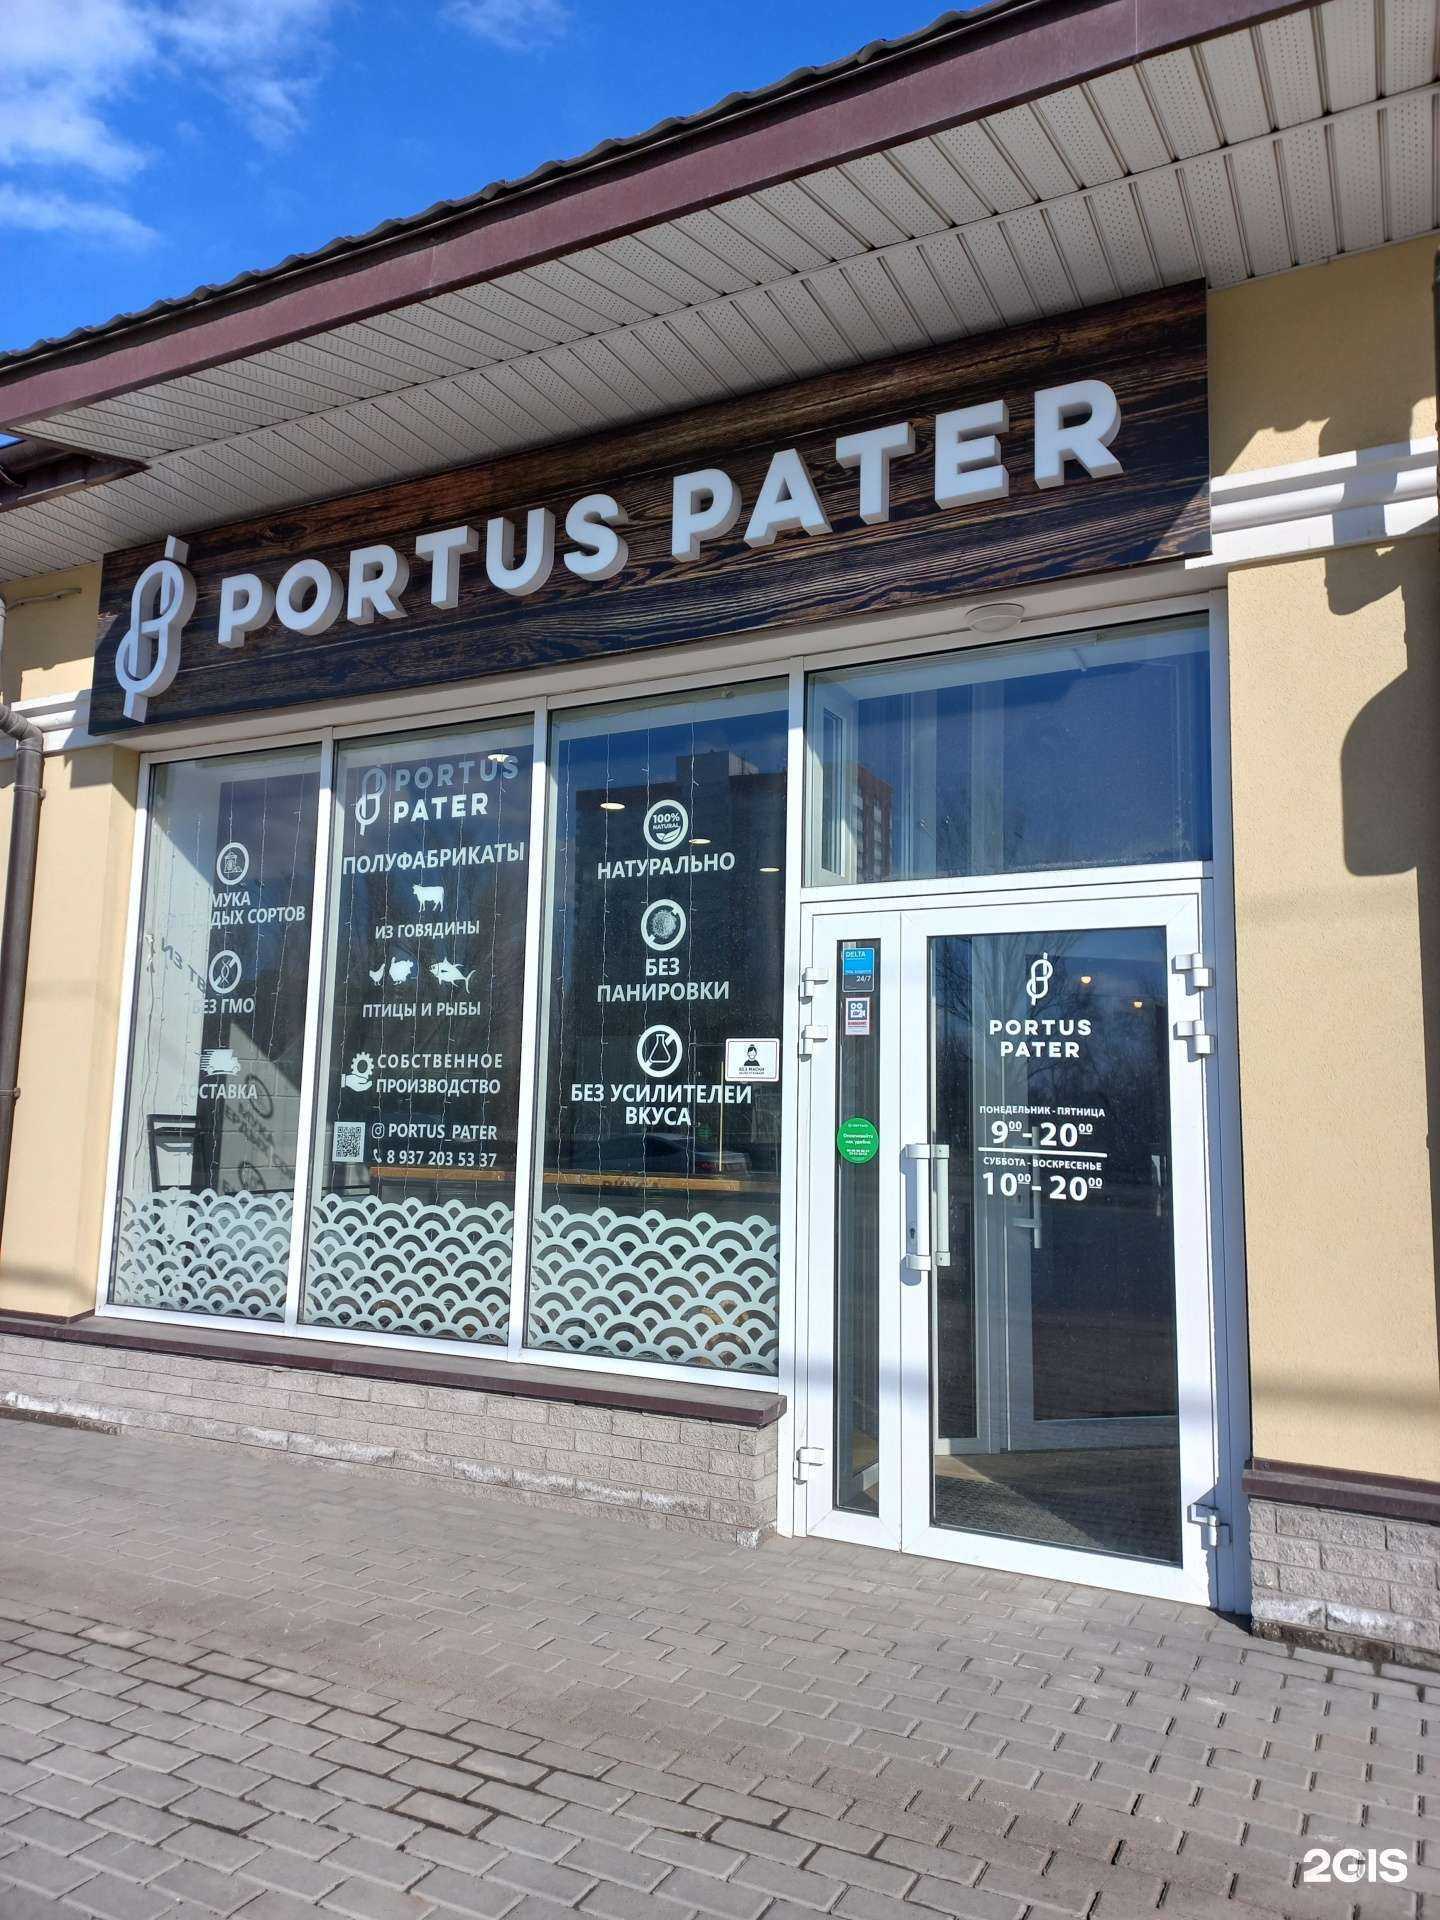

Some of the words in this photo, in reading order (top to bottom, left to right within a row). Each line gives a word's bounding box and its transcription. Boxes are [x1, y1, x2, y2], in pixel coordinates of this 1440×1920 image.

[219, 494, 629, 648] PORTUS
[671, 379, 1122, 562] PATER
[395, 755, 519, 791] PORTUS
[394, 793, 488, 823] PATER
[652, 812, 680, 824] 100%
[343, 842, 524, 874] ПОЛУФАБРИКАТЫ
[597, 852, 736, 880] НАТУРАЛЬНО
[212, 891, 250, 907] МУКА
[248, 906, 305, 924] СОРТОВ
[375, 924, 394, 940] ИЗ
[398, 920, 480, 939] ГОВЯДИНЫ
[645, 957, 680, 977] БЕЗ
[597, 981, 730, 1003] ПАНИРОВКИ
[221, 998, 254, 1014] ГМО
[363, 1003, 416, 1019] ПТИЦЫ
[421, 1003, 431, 1017] И
[436, 1001, 481, 1017] РЫБЫ
[989, 1019, 1092, 1036] PORTUS
[1000, 1041, 1080, 1058] PATER
[377, 1053, 503, 1069] СОБСТВЕННОЕ
[183, 1083, 258, 1100] СТАВКА
[376, 1078, 500, 1097] ПРОИЗВОДСТВО
[571, 1083, 603, 1102] БЕЗ
[625, 1106, 692, 1126] ВКУСА
[979, 1105, 1051, 1115] ПОНЕДЕЛЬНИК
[1057, 1107, 1106, 1118] ПЯТНИЦА
[388, 1123, 498, 1142] PORTUS_PATER
[387, 1150, 395, 1164] 8
[399, 1150, 424, 1165] 937
[428, 1151, 453, 1166] 203
[458, 1152, 474, 1167] 53
[479, 1153, 497, 1167] 37
[983, 1156, 1026, 1167] СУББОТА
[1033, 1159, 1102, 1171] ВОСКРЕСЕНЬЕ
